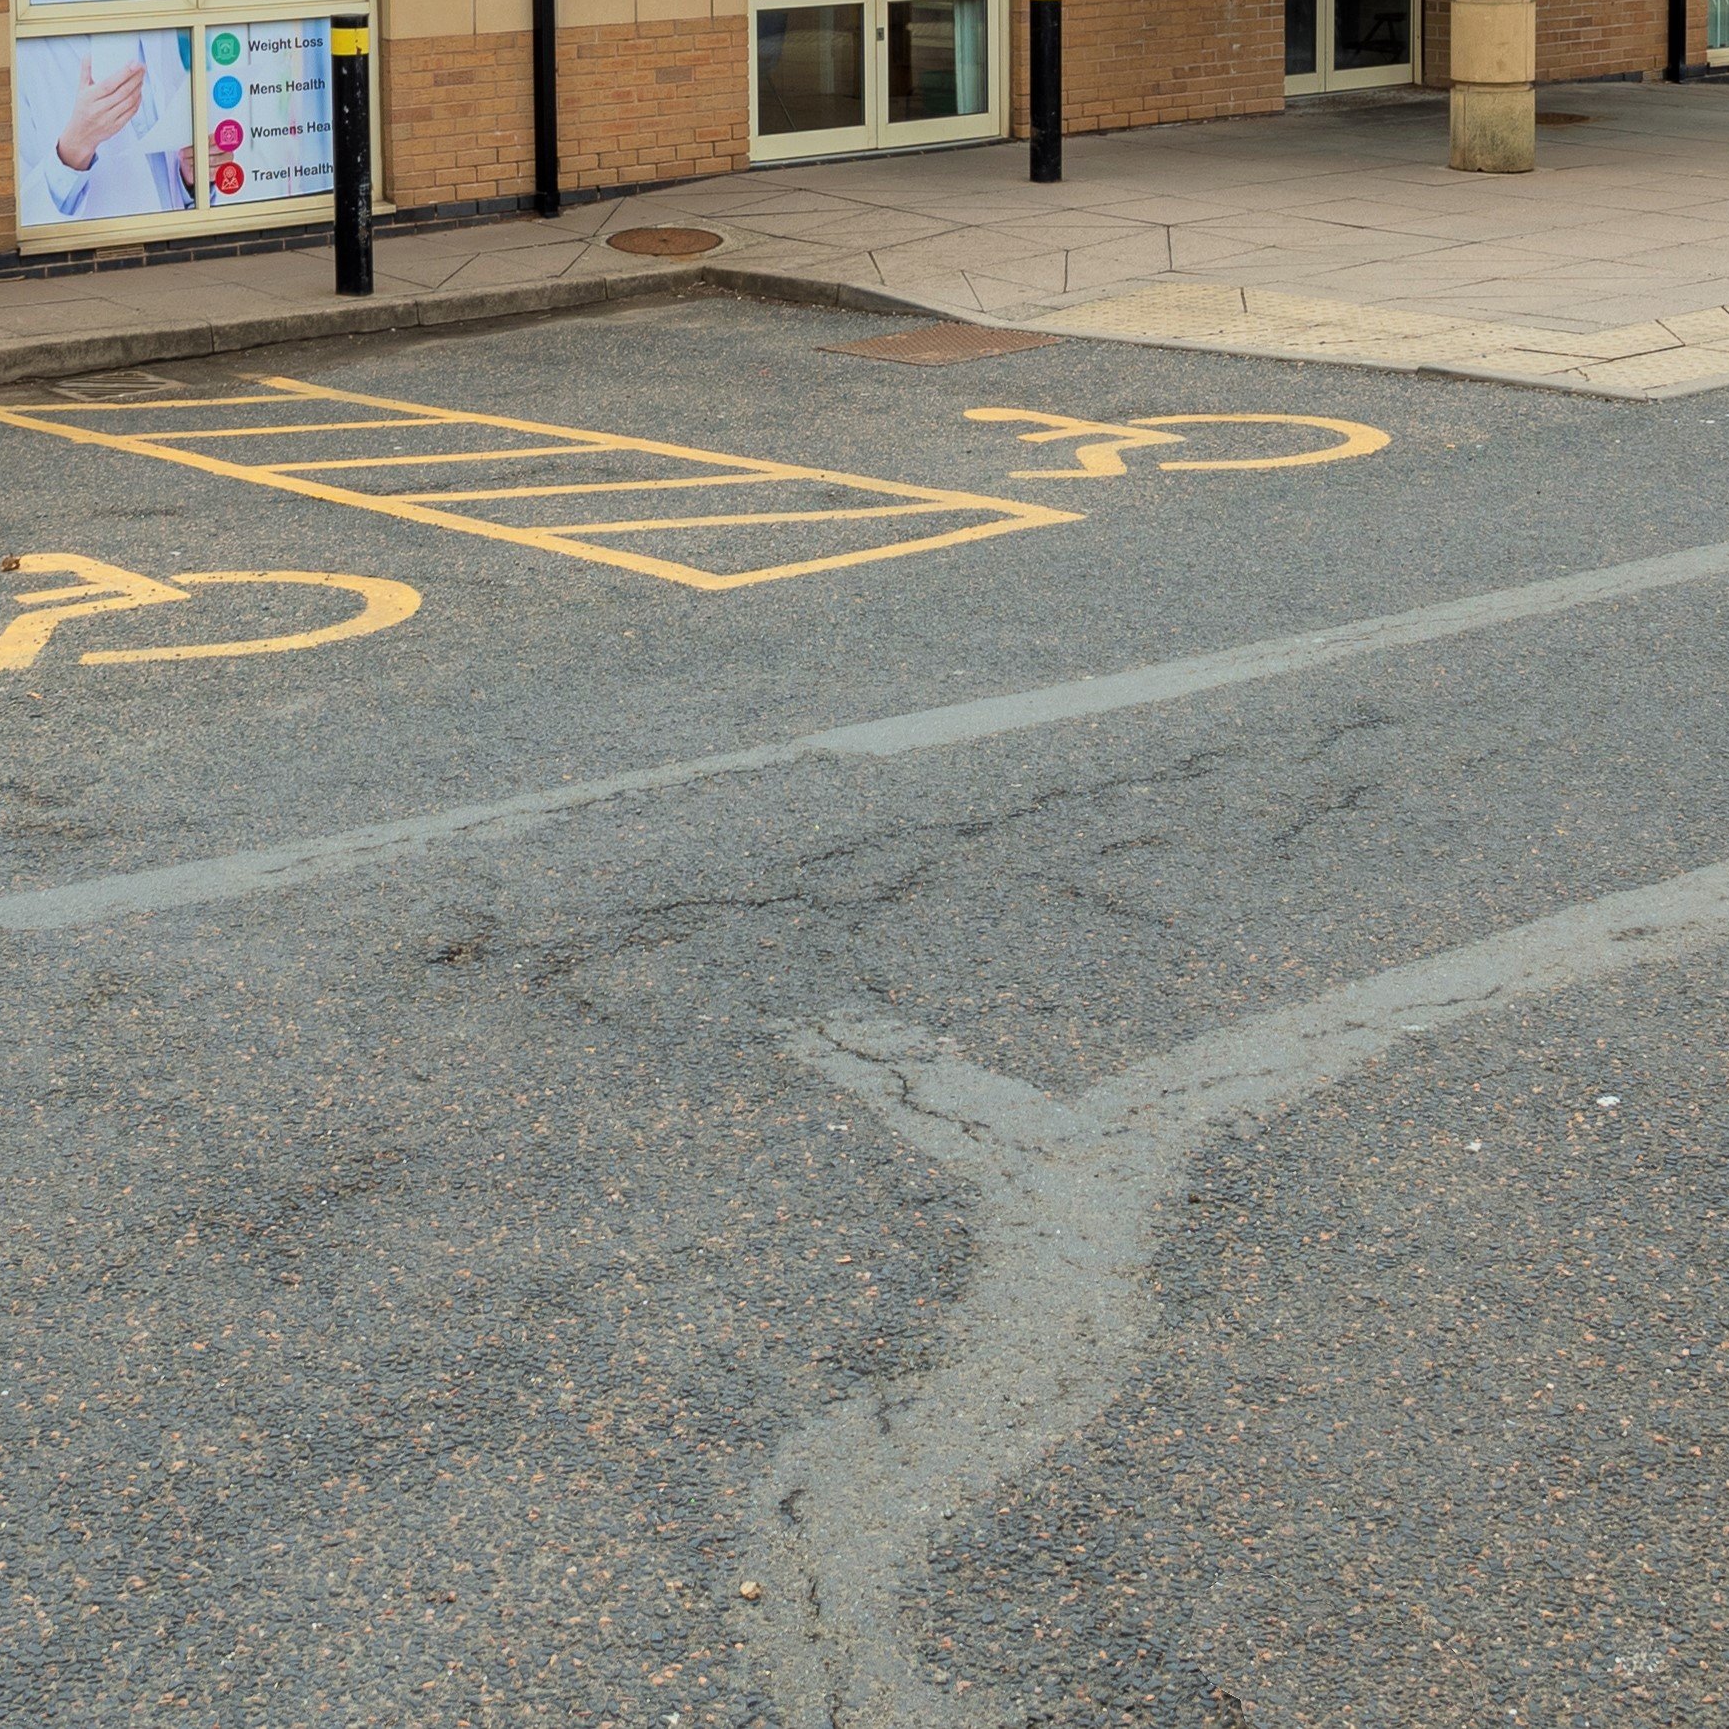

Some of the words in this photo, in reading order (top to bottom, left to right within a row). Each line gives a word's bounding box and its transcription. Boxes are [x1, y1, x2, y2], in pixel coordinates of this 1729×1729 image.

[248, 38, 292, 53] Weight
[294, 37, 323, 49] Loss
[249, 83, 282, 95] Mens
[286, 78, 326, 92] Health
[250, 125, 304, 138] Womens
[307, 121, 332, 133] Hea
[252, 167, 291, 181] Travel
[294, 162, 334, 177] Health
